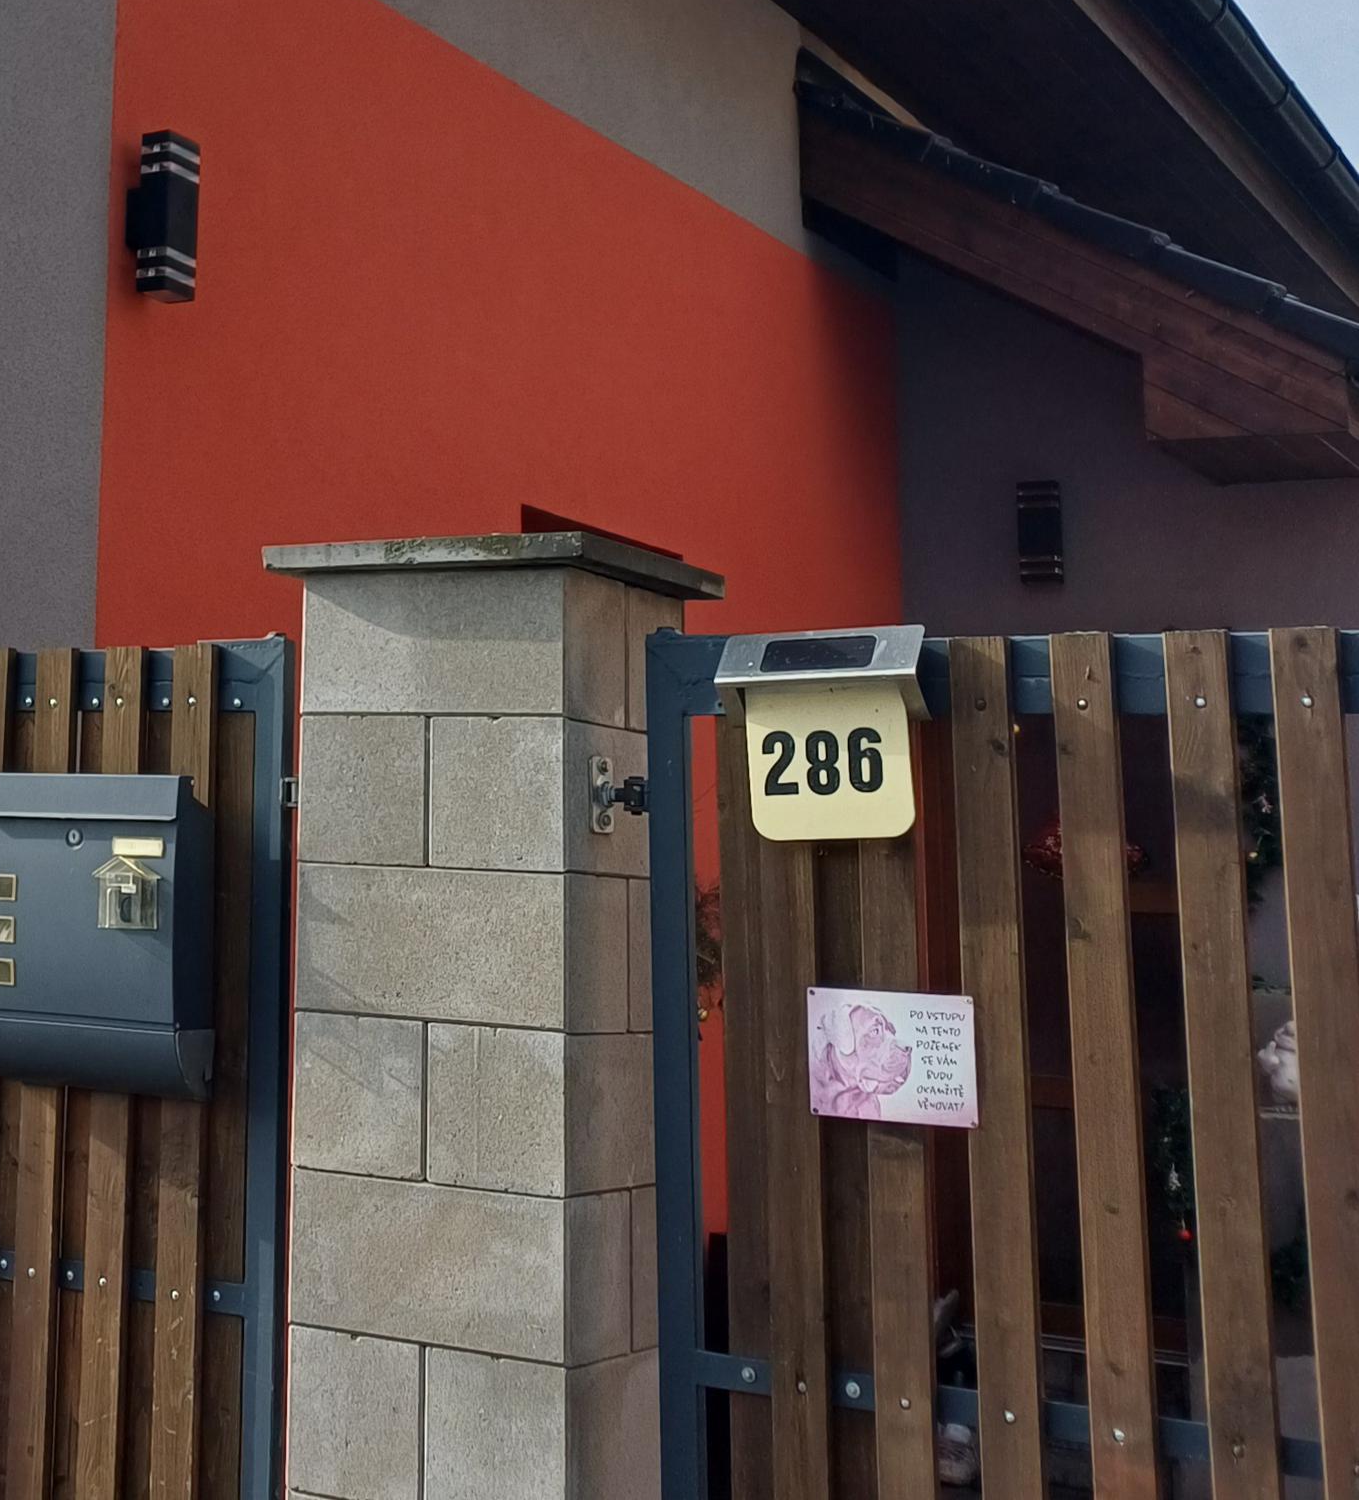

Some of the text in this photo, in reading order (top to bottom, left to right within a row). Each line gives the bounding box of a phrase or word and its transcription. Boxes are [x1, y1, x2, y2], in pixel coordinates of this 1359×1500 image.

[761, 726, 884, 797] 286
[909, 1010, 966, 1022] PO VSTUPU
[915, 1025, 961, 1037] NA TENTO
[921, 1053, 958, 1066] SE VÁM
[927, 1069, 953, 1080] BUDU
[916, 1083, 964, 1098] OKAMŽITĚ
[917, 1097, 965, 1111] VĚNOVAT!
